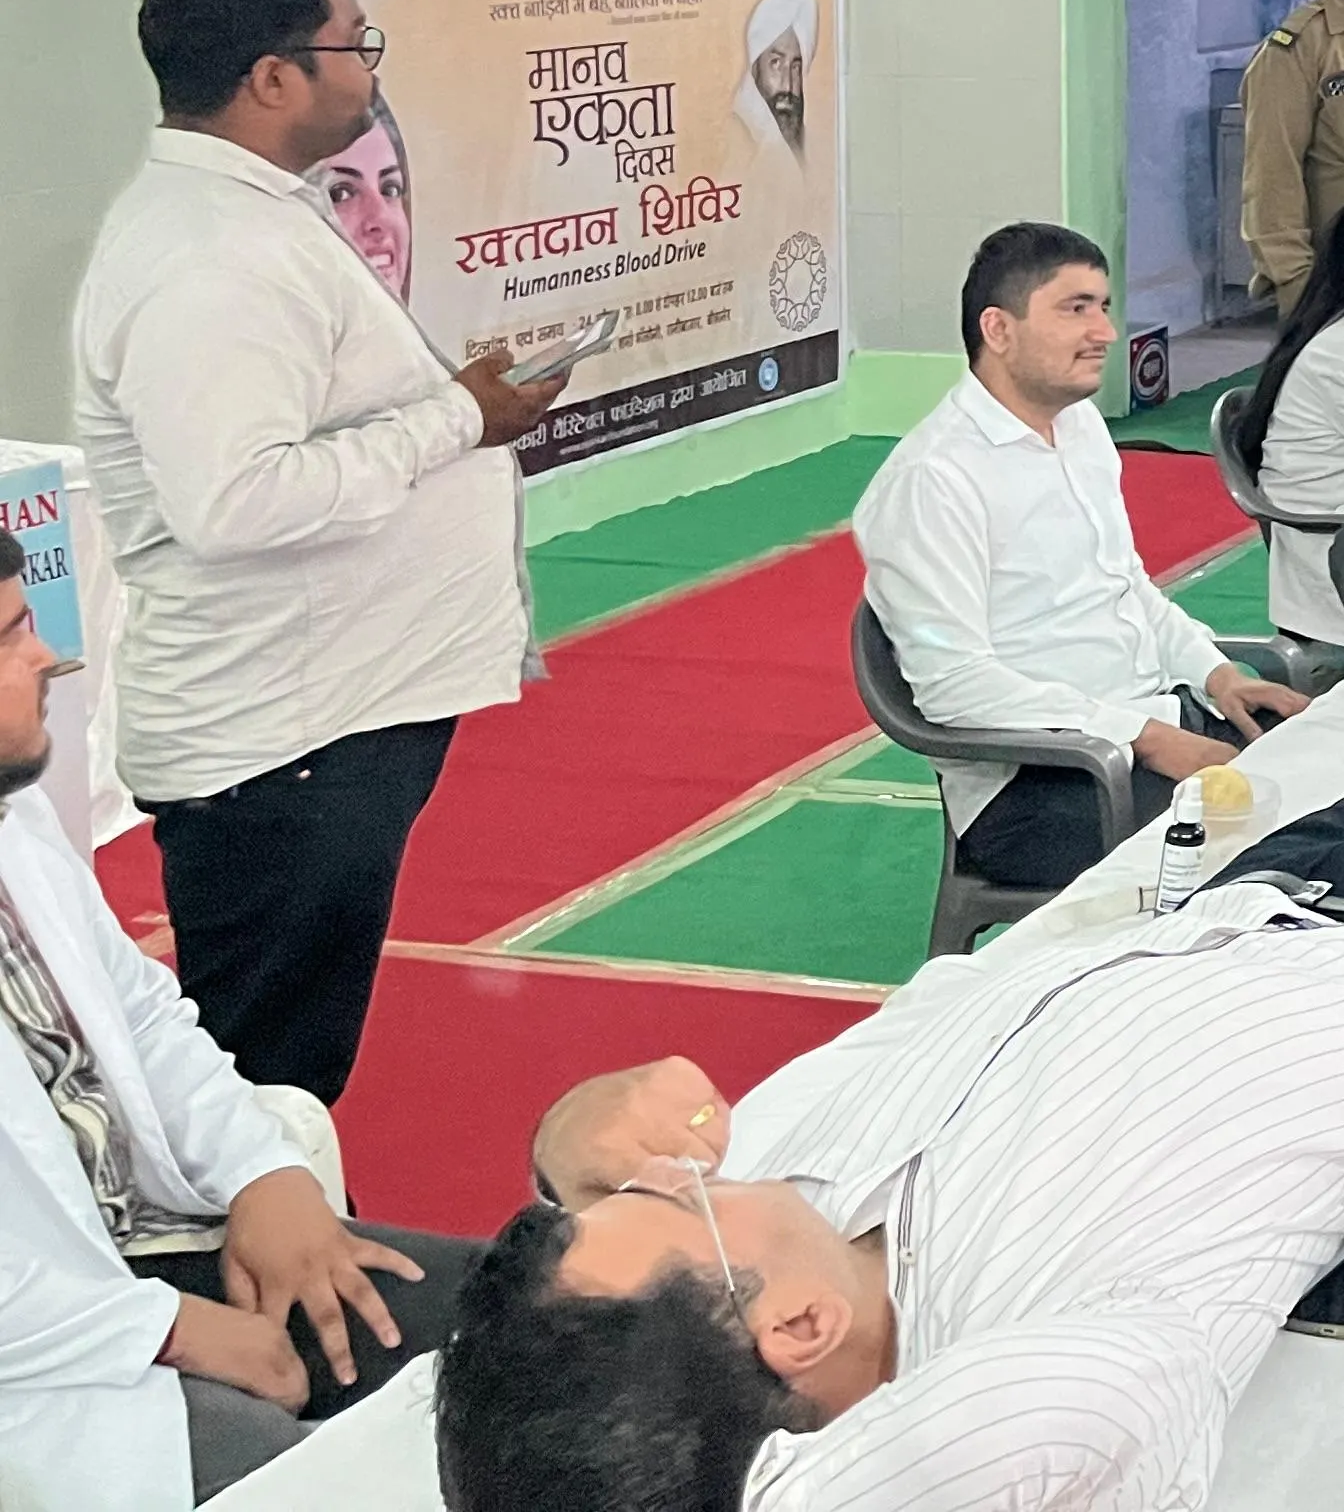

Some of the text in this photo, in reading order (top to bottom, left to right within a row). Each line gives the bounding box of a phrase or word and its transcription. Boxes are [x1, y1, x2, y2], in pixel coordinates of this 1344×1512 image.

[526, 41, 628, 92] मानव
[530, 82, 676, 166] एकता
[614, 139, 675, 183] दिवस
[455, 175, 742, 274] रक्तदान शिविर
[504, 239, 706, 301] Humanness Blood Drive
